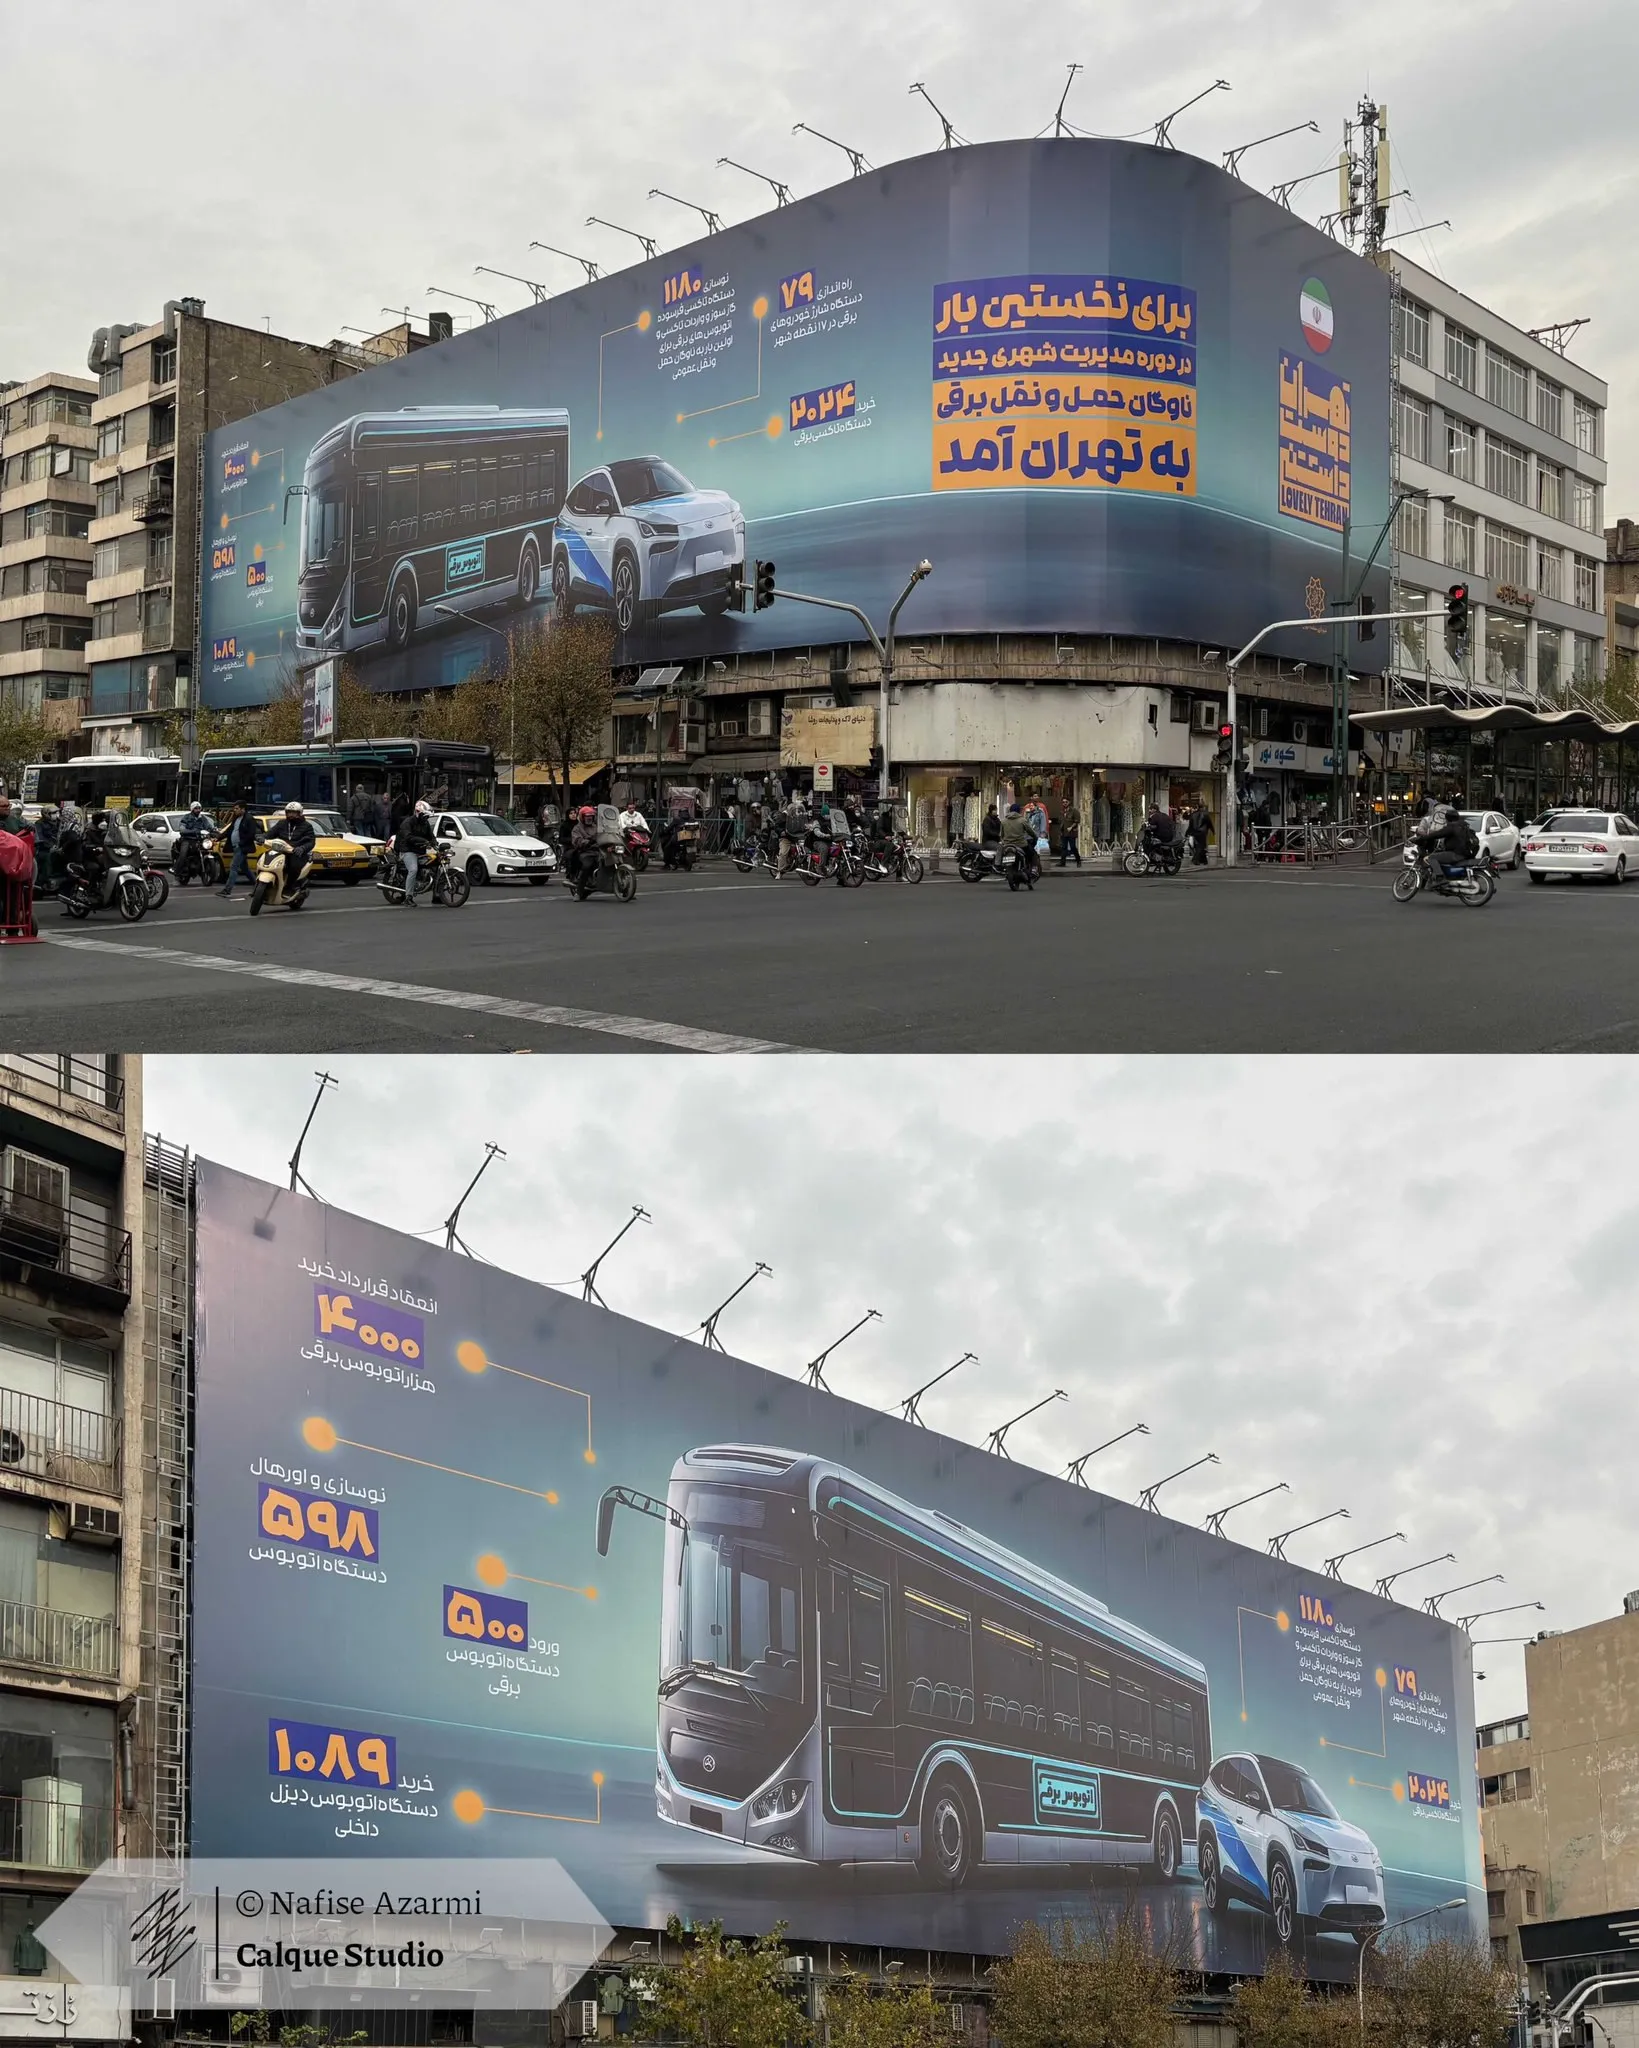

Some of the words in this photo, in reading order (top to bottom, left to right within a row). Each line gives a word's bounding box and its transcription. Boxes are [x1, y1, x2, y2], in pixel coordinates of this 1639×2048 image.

[664, 271, 701, 305] ۱۱۸۰
[703, 272, 729, 293] نوسازی
[781, 271, 814, 309] ۷۹
[684, 296, 707, 315] تاکسی
[708, 288, 735, 304] دستگاه
[830, 292, 863, 310] دستگاه
[982, 279, 1129, 329] نخستین
[657, 302, 684, 322] فرسوده
[770, 307, 810, 332] خودروهای
[810, 303, 829, 319] شارژ
[837, 310, 858, 328] برقی
[935, 292, 977, 333] بار
[1132, 293, 1192, 339] برای
[661, 320, 683, 338] تاکسی
[704, 319, 732, 339] اتوبوس
[793, 322, 817, 339] نقطه
[828, 319, 837, 331] در
[659, 341, 672, 354] برای
[672, 333, 688, 350] برقی
[713, 335, 733, 351] اولین
[773, 331, 792, 348] شهر
[657, 356, 673, 369] حمل
[938, 346, 988, 373] جدید
[991, 341, 1057, 367] شهری
[1060, 344, 1135, 369] مدیریت
[1137, 350, 1176, 373] دوره
[672, 364, 696, 380] عمومی
[1177, 356, 1192, 376] در
[791, 382, 855, 427] ۲۰۲۴
[856, 395, 876, 413] خرید
[937, 381, 988, 419] برقی
[1063, 386, 1125, 414] حمل
[1128, 390, 1192, 421] ناوگان
[812, 422, 840, 442] تاکسی
[840, 417, 872, 432] دستگاه
[794, 429, 812, 446] برقی
[939, 425, 1016, 473] آمد
[1020, 428, 1144, 485] تهران
[1150, 439, 1191, 491] به
[1281, 484, 1313, 517] LOVELY
[1315, 496, 1348, 526] TEHRAN
[298, 1257, 336, 1280] خرید
[390, 1289, 438, 1315] انعقاد
[317, 1294, 420, 1359] ۴۰۰۰
[300, 1339, 340, 1368] برقی
[250, 1457, 307, 1485] اورهال
[310, 1473, 320, 1490] و
[323, 1479, 386, 1503] نوسازی
[261, 1487, 375, 1557] ۵۹۸
[248, 1546, 320, 1571] اتوبوس
[323, 1556, 388, 1584] دستگاه
[447, 1590, 525, 1643] ۵۰۰
[1300, 1594, 1333, 1626] ۱۱۸۰
[528, 1637, 560, 1656] ورود
[445, 1648, 506, 1669] اتوبوس
[506, 1655, 561, 1678] دستگاه
[488, 1675, 521, 1699] برقی
[1394, 1667, 1417, 1696] ۷۹
[275, 1728, 390, 1786] ۱۰۸۹
[270, 1784, 309, 1805] دیزل
[398, 1774, 434, 1793] خرید
[1408, 1775, 1449, 1805] ۲۰۲۴
[310, 1791, 377, 1812] اتوبوس
[378, 1797, 438, 1817] دستگاه
[1061, 1789, 1094, 1808] اتوبوس
[335, 1818, 379, 1837] داخلی
